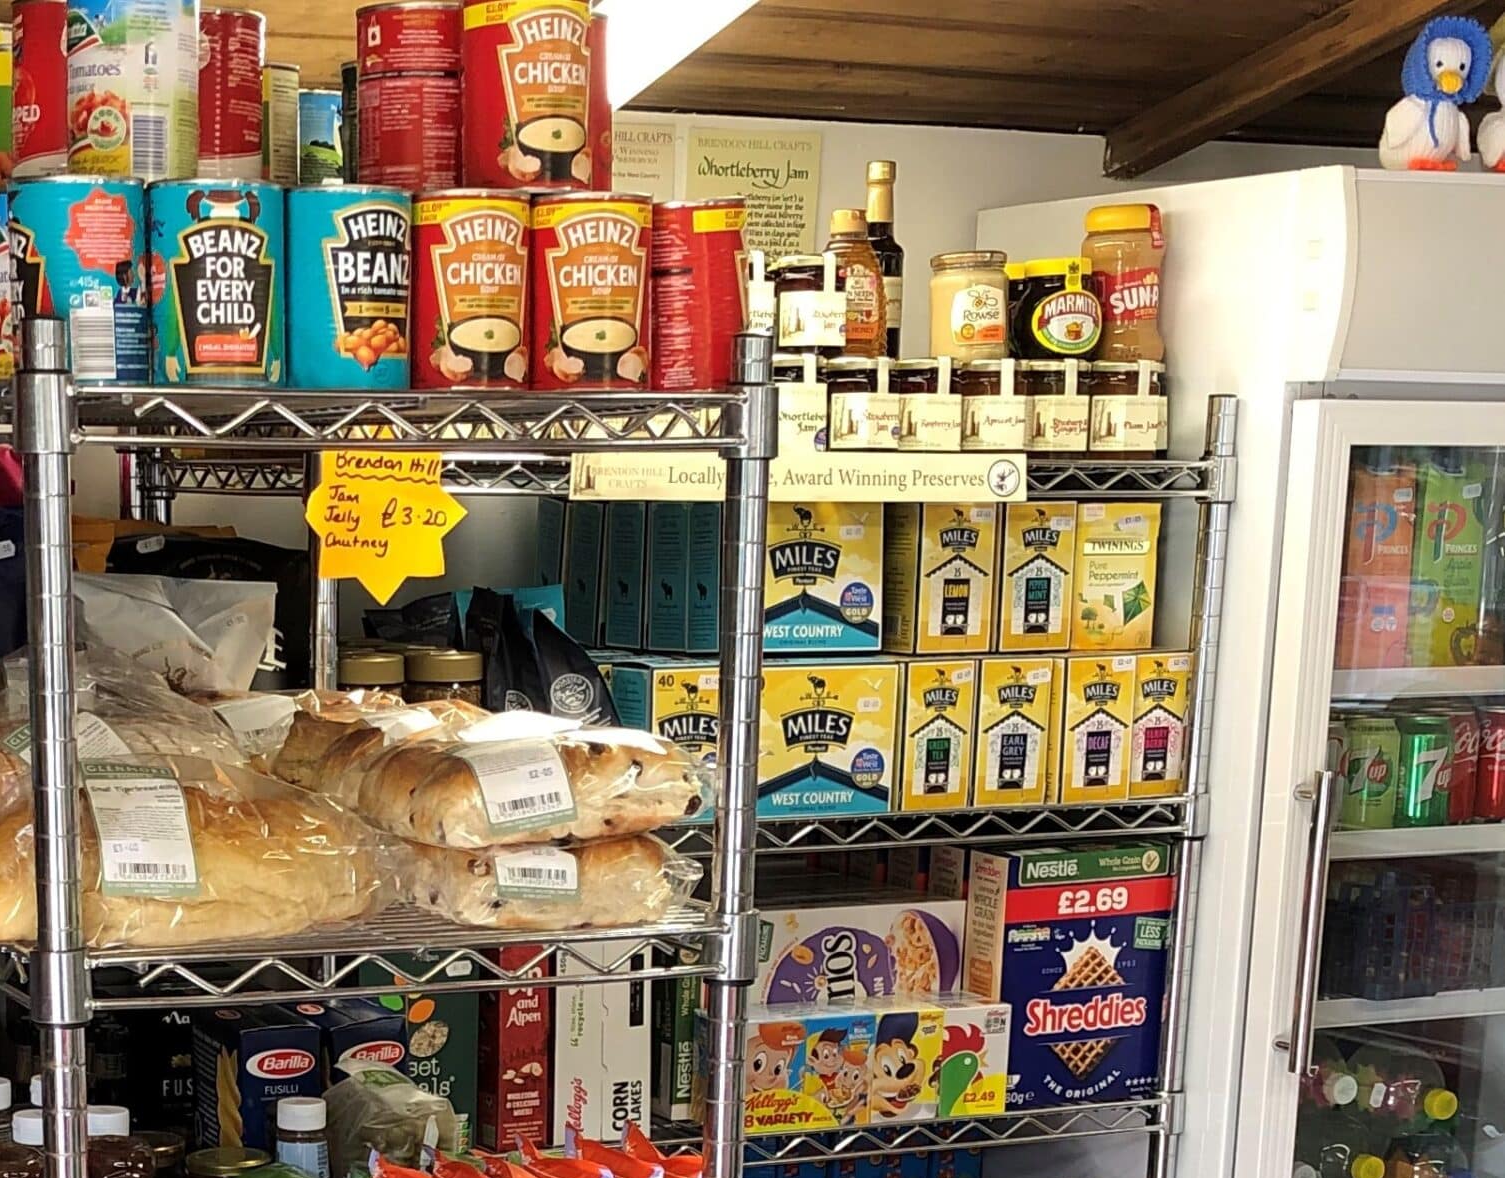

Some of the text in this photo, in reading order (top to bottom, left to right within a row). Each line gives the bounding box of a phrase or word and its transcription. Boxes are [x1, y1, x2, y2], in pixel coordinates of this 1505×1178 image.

[523, 16, 582, 46] HEINZ
[514, 62, 586, 86] CHICKEN
[634, 132, 673, 143] CRAFTS
[698, 137, 813, 151] BRENDON HILL CRAFTS
[349, 213, 406, 242] HEINZ
[457, 218, 517, 245] HEINZ
[568, 218, 635, 248] HEINZ
[188, 229, 259, 258] BEANZ
[205, 256, 245, 279] FOR
[336, 250, 409, 285] BEANZ
[447, 262, 521, 286] CHICKEN
[559, 265, 637, 287] CHICKEN
[195, 278, 255, 302] EVERY
[195, 302, 256, 325] CHILD
[962, 308, 1000, 322] Rowse
[1044, 297, 1098, 319] MARMITE
[336, 452, 440, 476] Brendon Hill
[668, 466, 725, 488] Locally
[783, 468, 985, 491] Award Winning Preserves
[329, 485, 360, 503] Jam
[324, 505, 360, 532] Jelly
[325, 532, 388, 558] Chutney
[941, 531, 977, 543] MILES
[1024, 531, 1058, 543] MILES
[1091, 540, 1144, 551] TWININGS
[775, 548, 838, 569] MILES
[1088, 570, 1139, 582] Peppermint
[793, 624, 844, 638] COUNTRY
[658, 674, 675, 687] 40
[1142, 680, 1175, 692] MILES
[925, 691, 958, 703] MILES
[999, 686, 1035, 700] MILES
[1085, 686, 1119, 697] MILES
[787, 716, 852, 737] MILES
[1002, 736, 1025, 745] EARL
[1002, 745, 1025, 756] GREY
[856, 773, 878, 782] GOLD
[772, 791, 854, 805] WEST COUNTRY
[1027, 859, 1079, 879] Nestlé
[1058, 886, 1129, 914] £2.69
[506, 1010, 542, 1029] Alpen
[1024, 995, 1147, 1036] Shreddies
[263, 1055, 310, 1073] Barilla
[264, 1084, 299, 1095] FUSILLI
[612, 1081, 629, 1132] CORN
